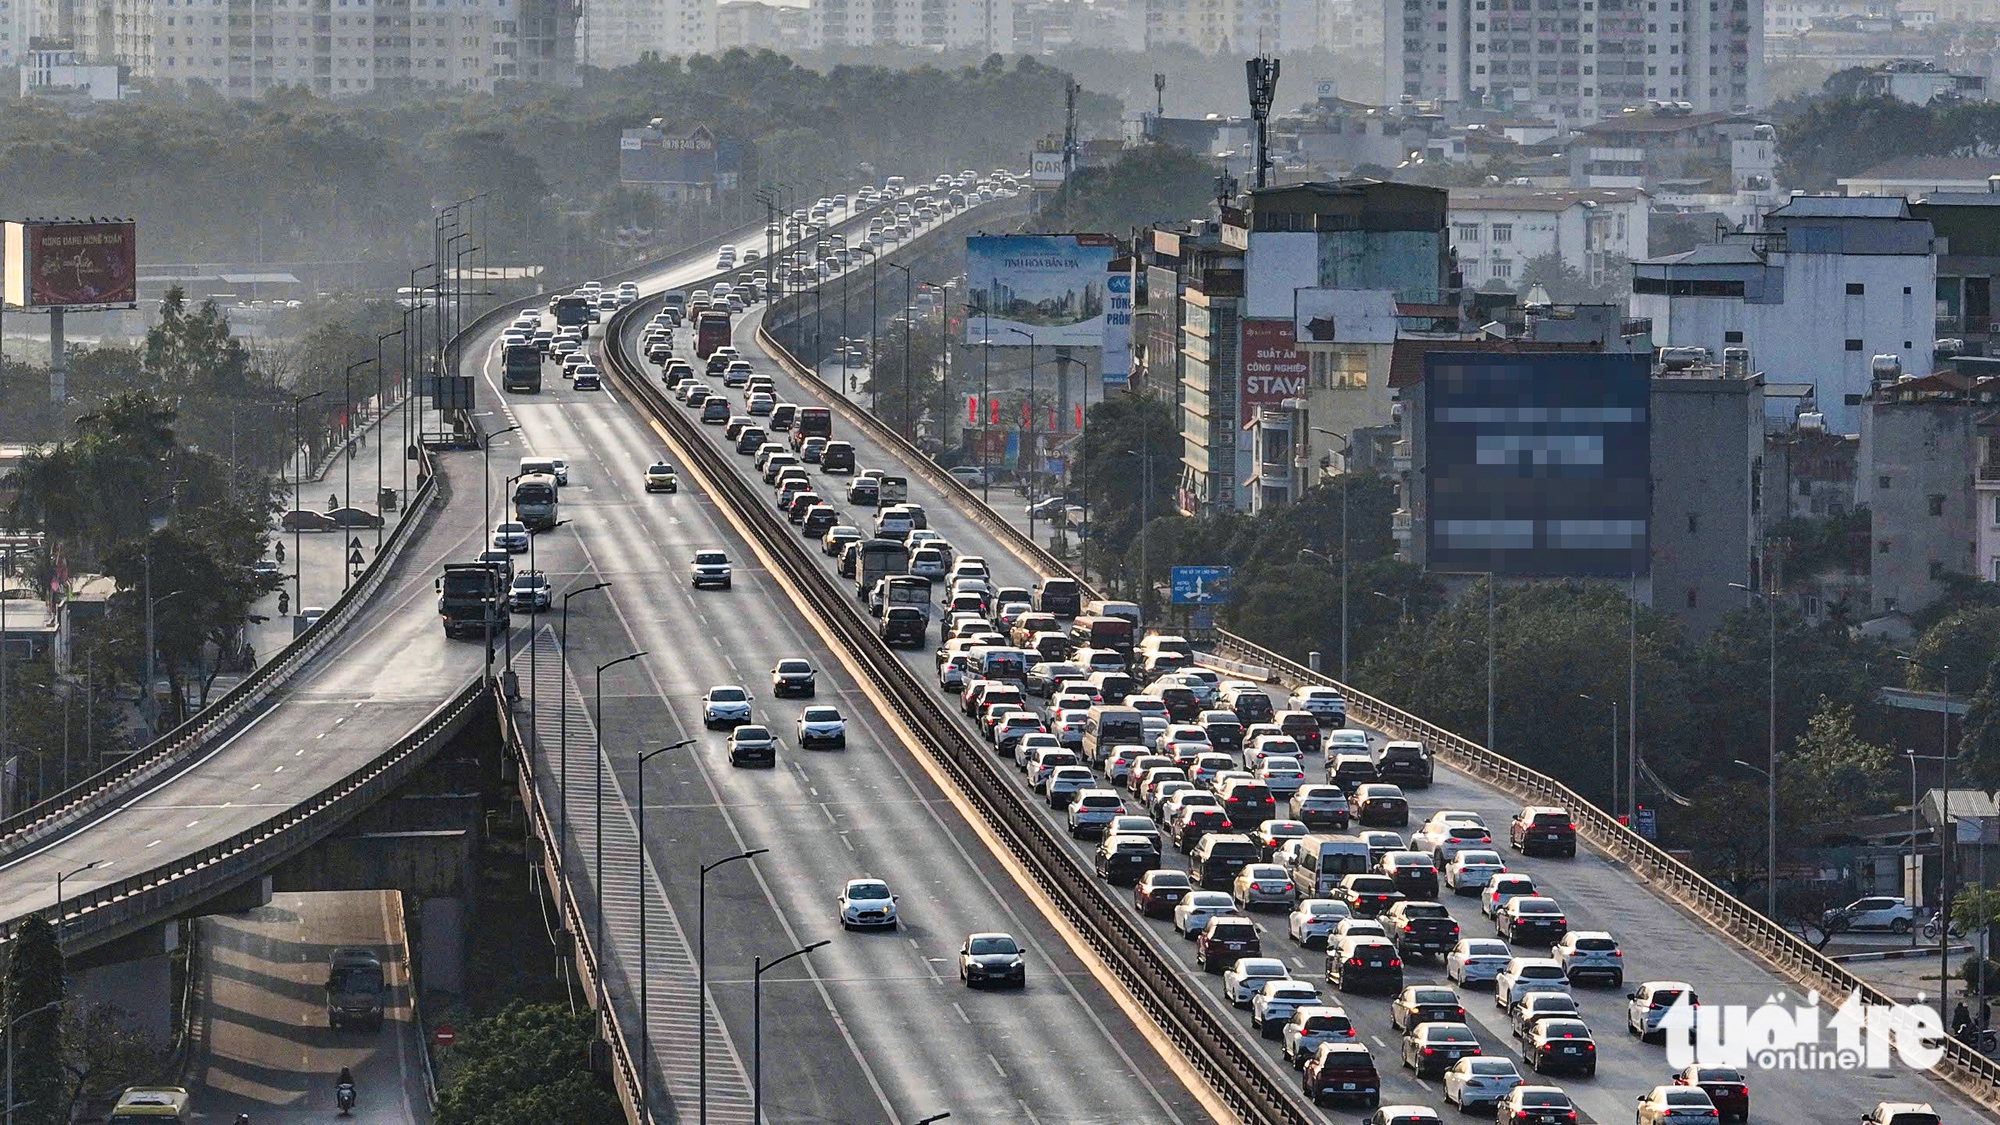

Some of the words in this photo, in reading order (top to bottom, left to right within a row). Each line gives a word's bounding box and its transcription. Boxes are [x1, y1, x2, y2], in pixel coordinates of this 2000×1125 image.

[1257, 347, 1282, 359] SUẤT
[1246, 361, 1271, 372] CÔNG
[1274, 363, 1307, 374] NGHIỆP
